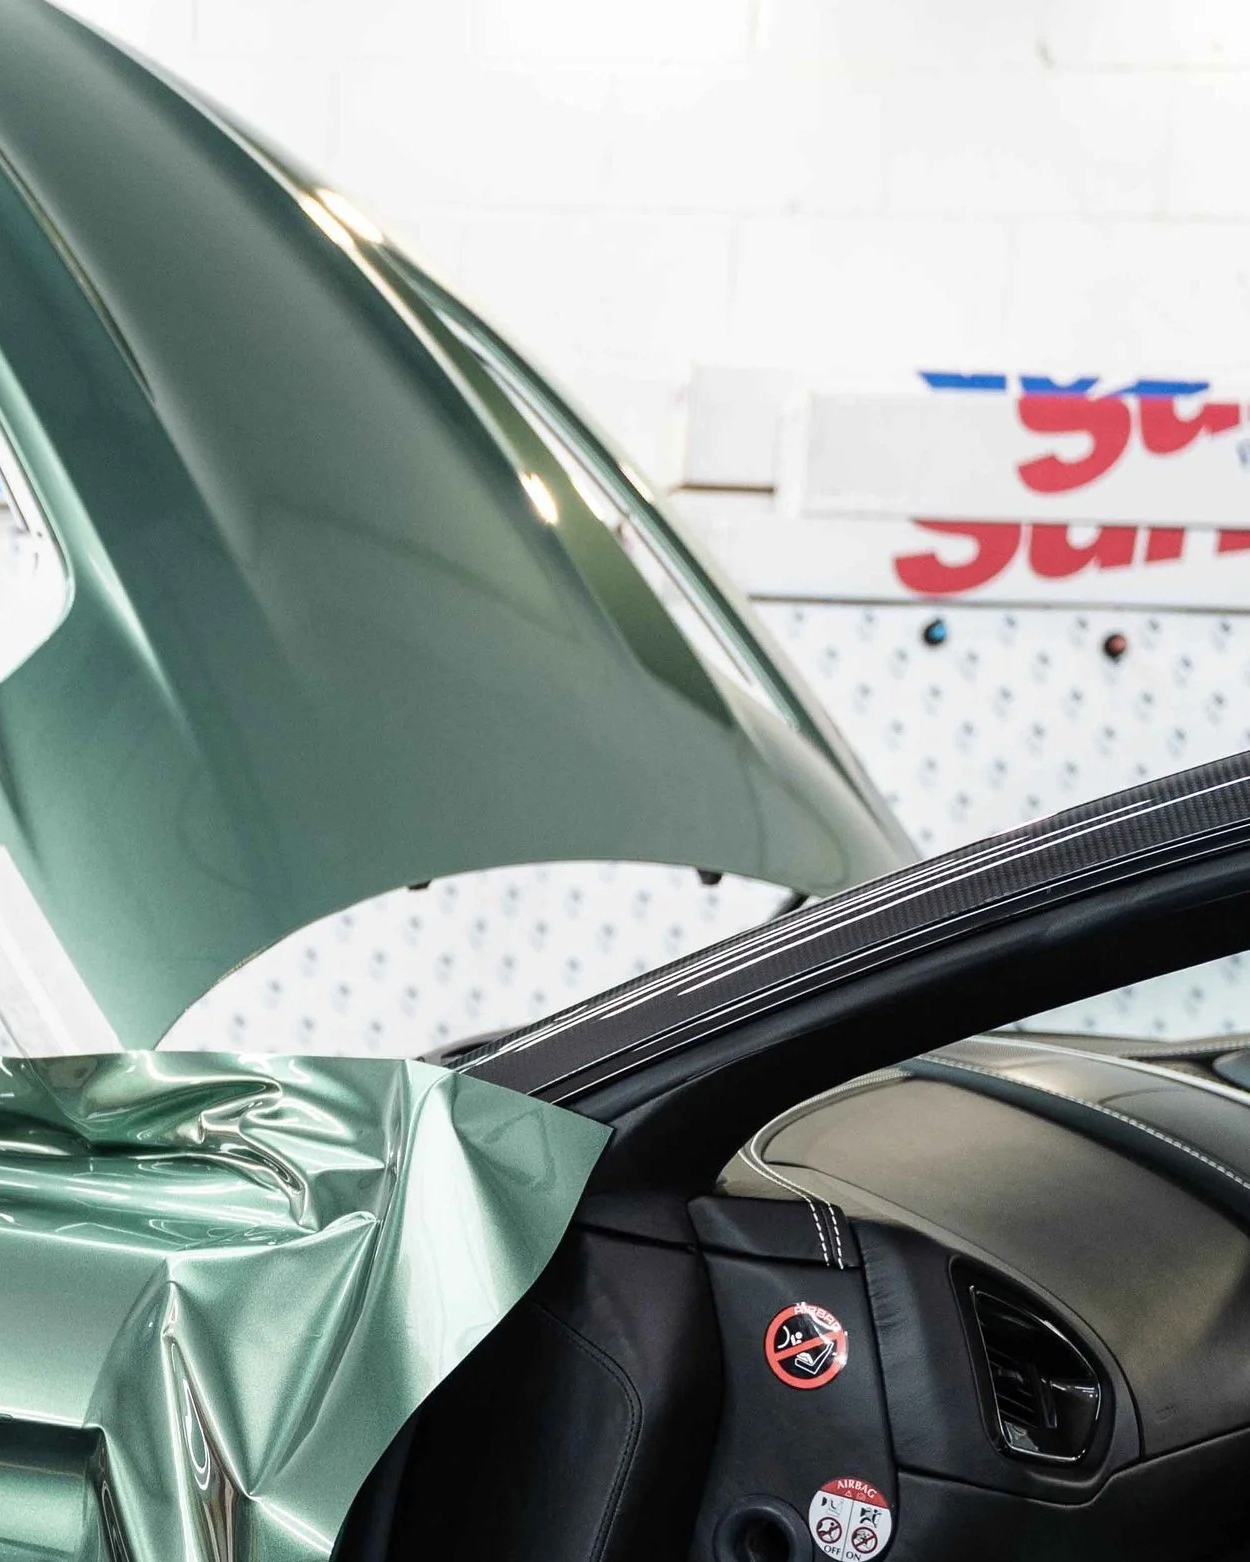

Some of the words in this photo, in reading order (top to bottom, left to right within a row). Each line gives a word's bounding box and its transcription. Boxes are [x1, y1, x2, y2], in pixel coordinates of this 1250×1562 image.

[837, 1480, 877, 1499] AIRBAG
[823, 1545, 841, 1555] OFF
[845, 1551, 861, 1561] ON
